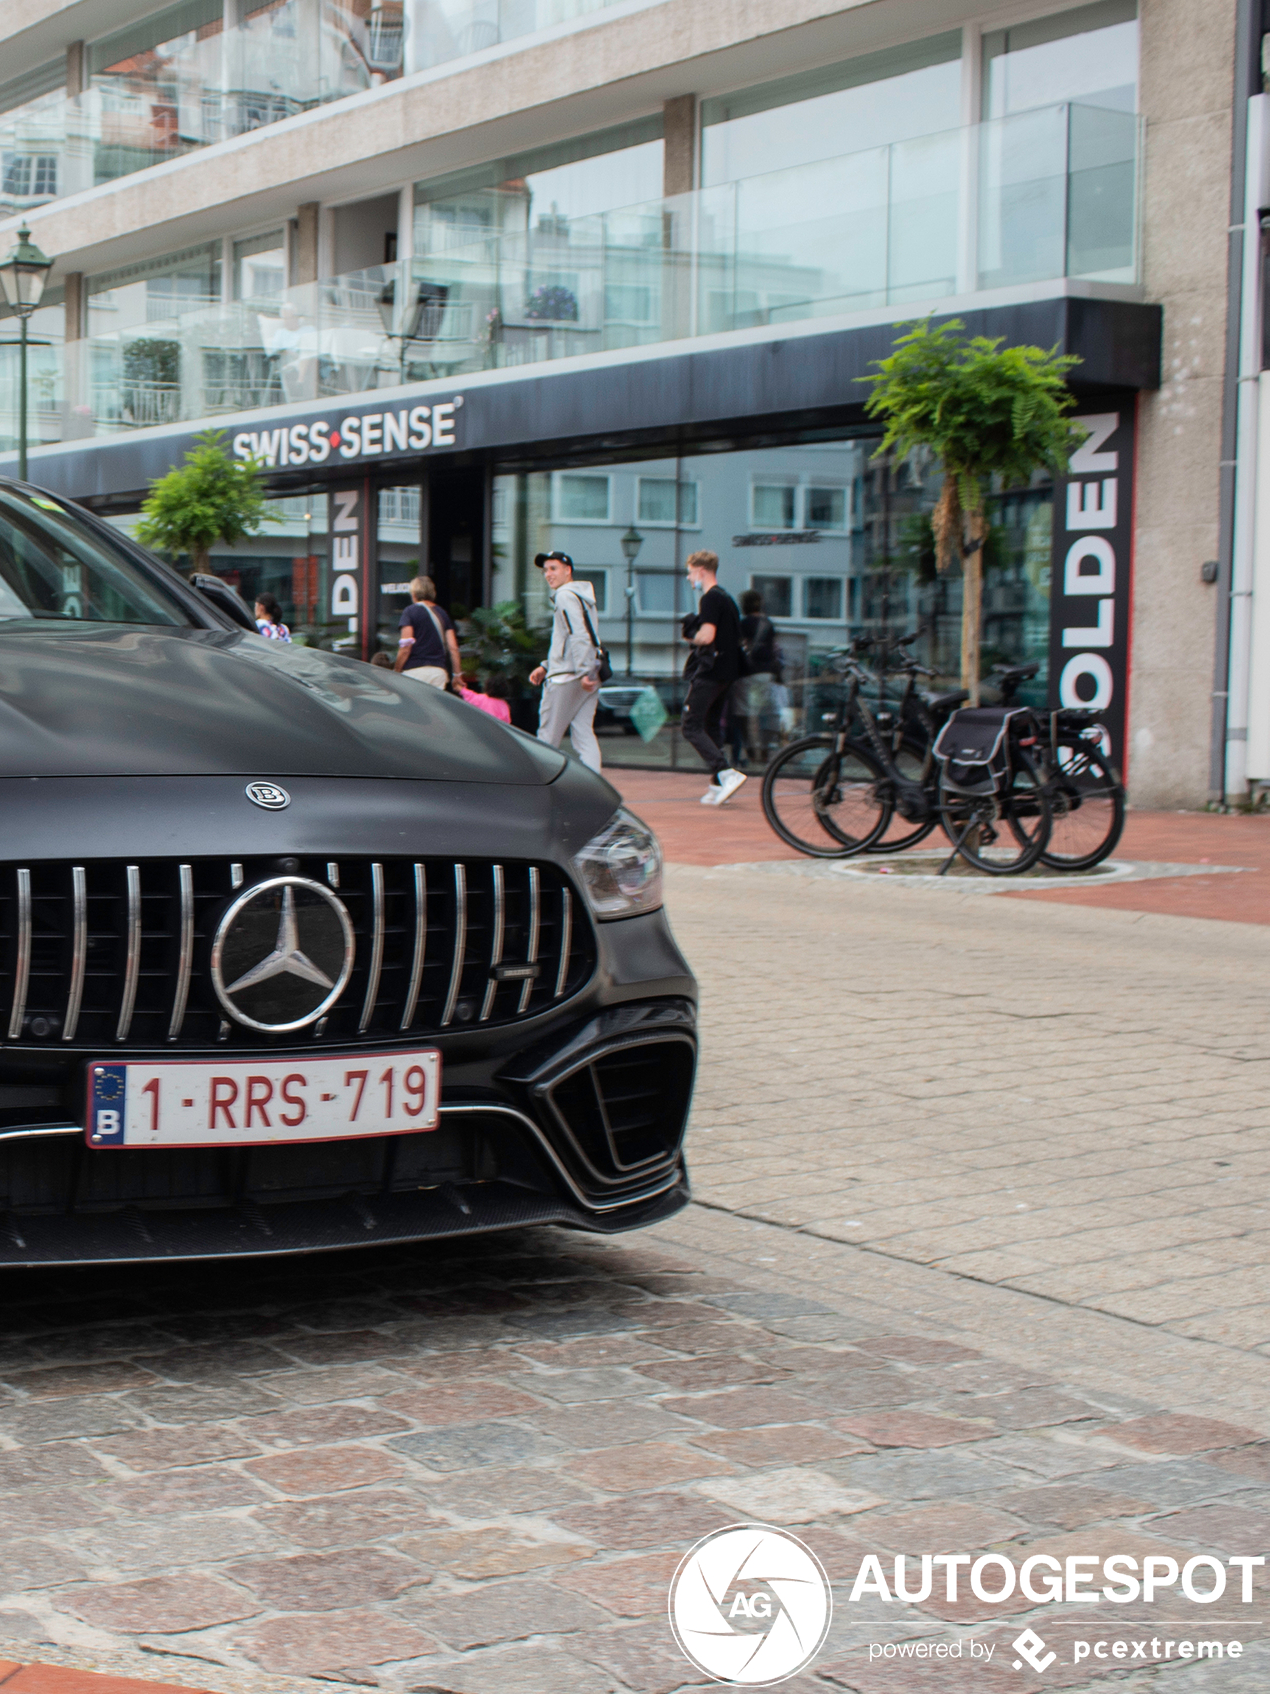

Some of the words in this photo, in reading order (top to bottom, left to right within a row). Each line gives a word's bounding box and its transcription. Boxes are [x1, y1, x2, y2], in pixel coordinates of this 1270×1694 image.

[233, 421, 330, 471] SWISS
[96, 1110, 120, 1135] B
[141, 1065, 427, 1130] 1-RRS-719
